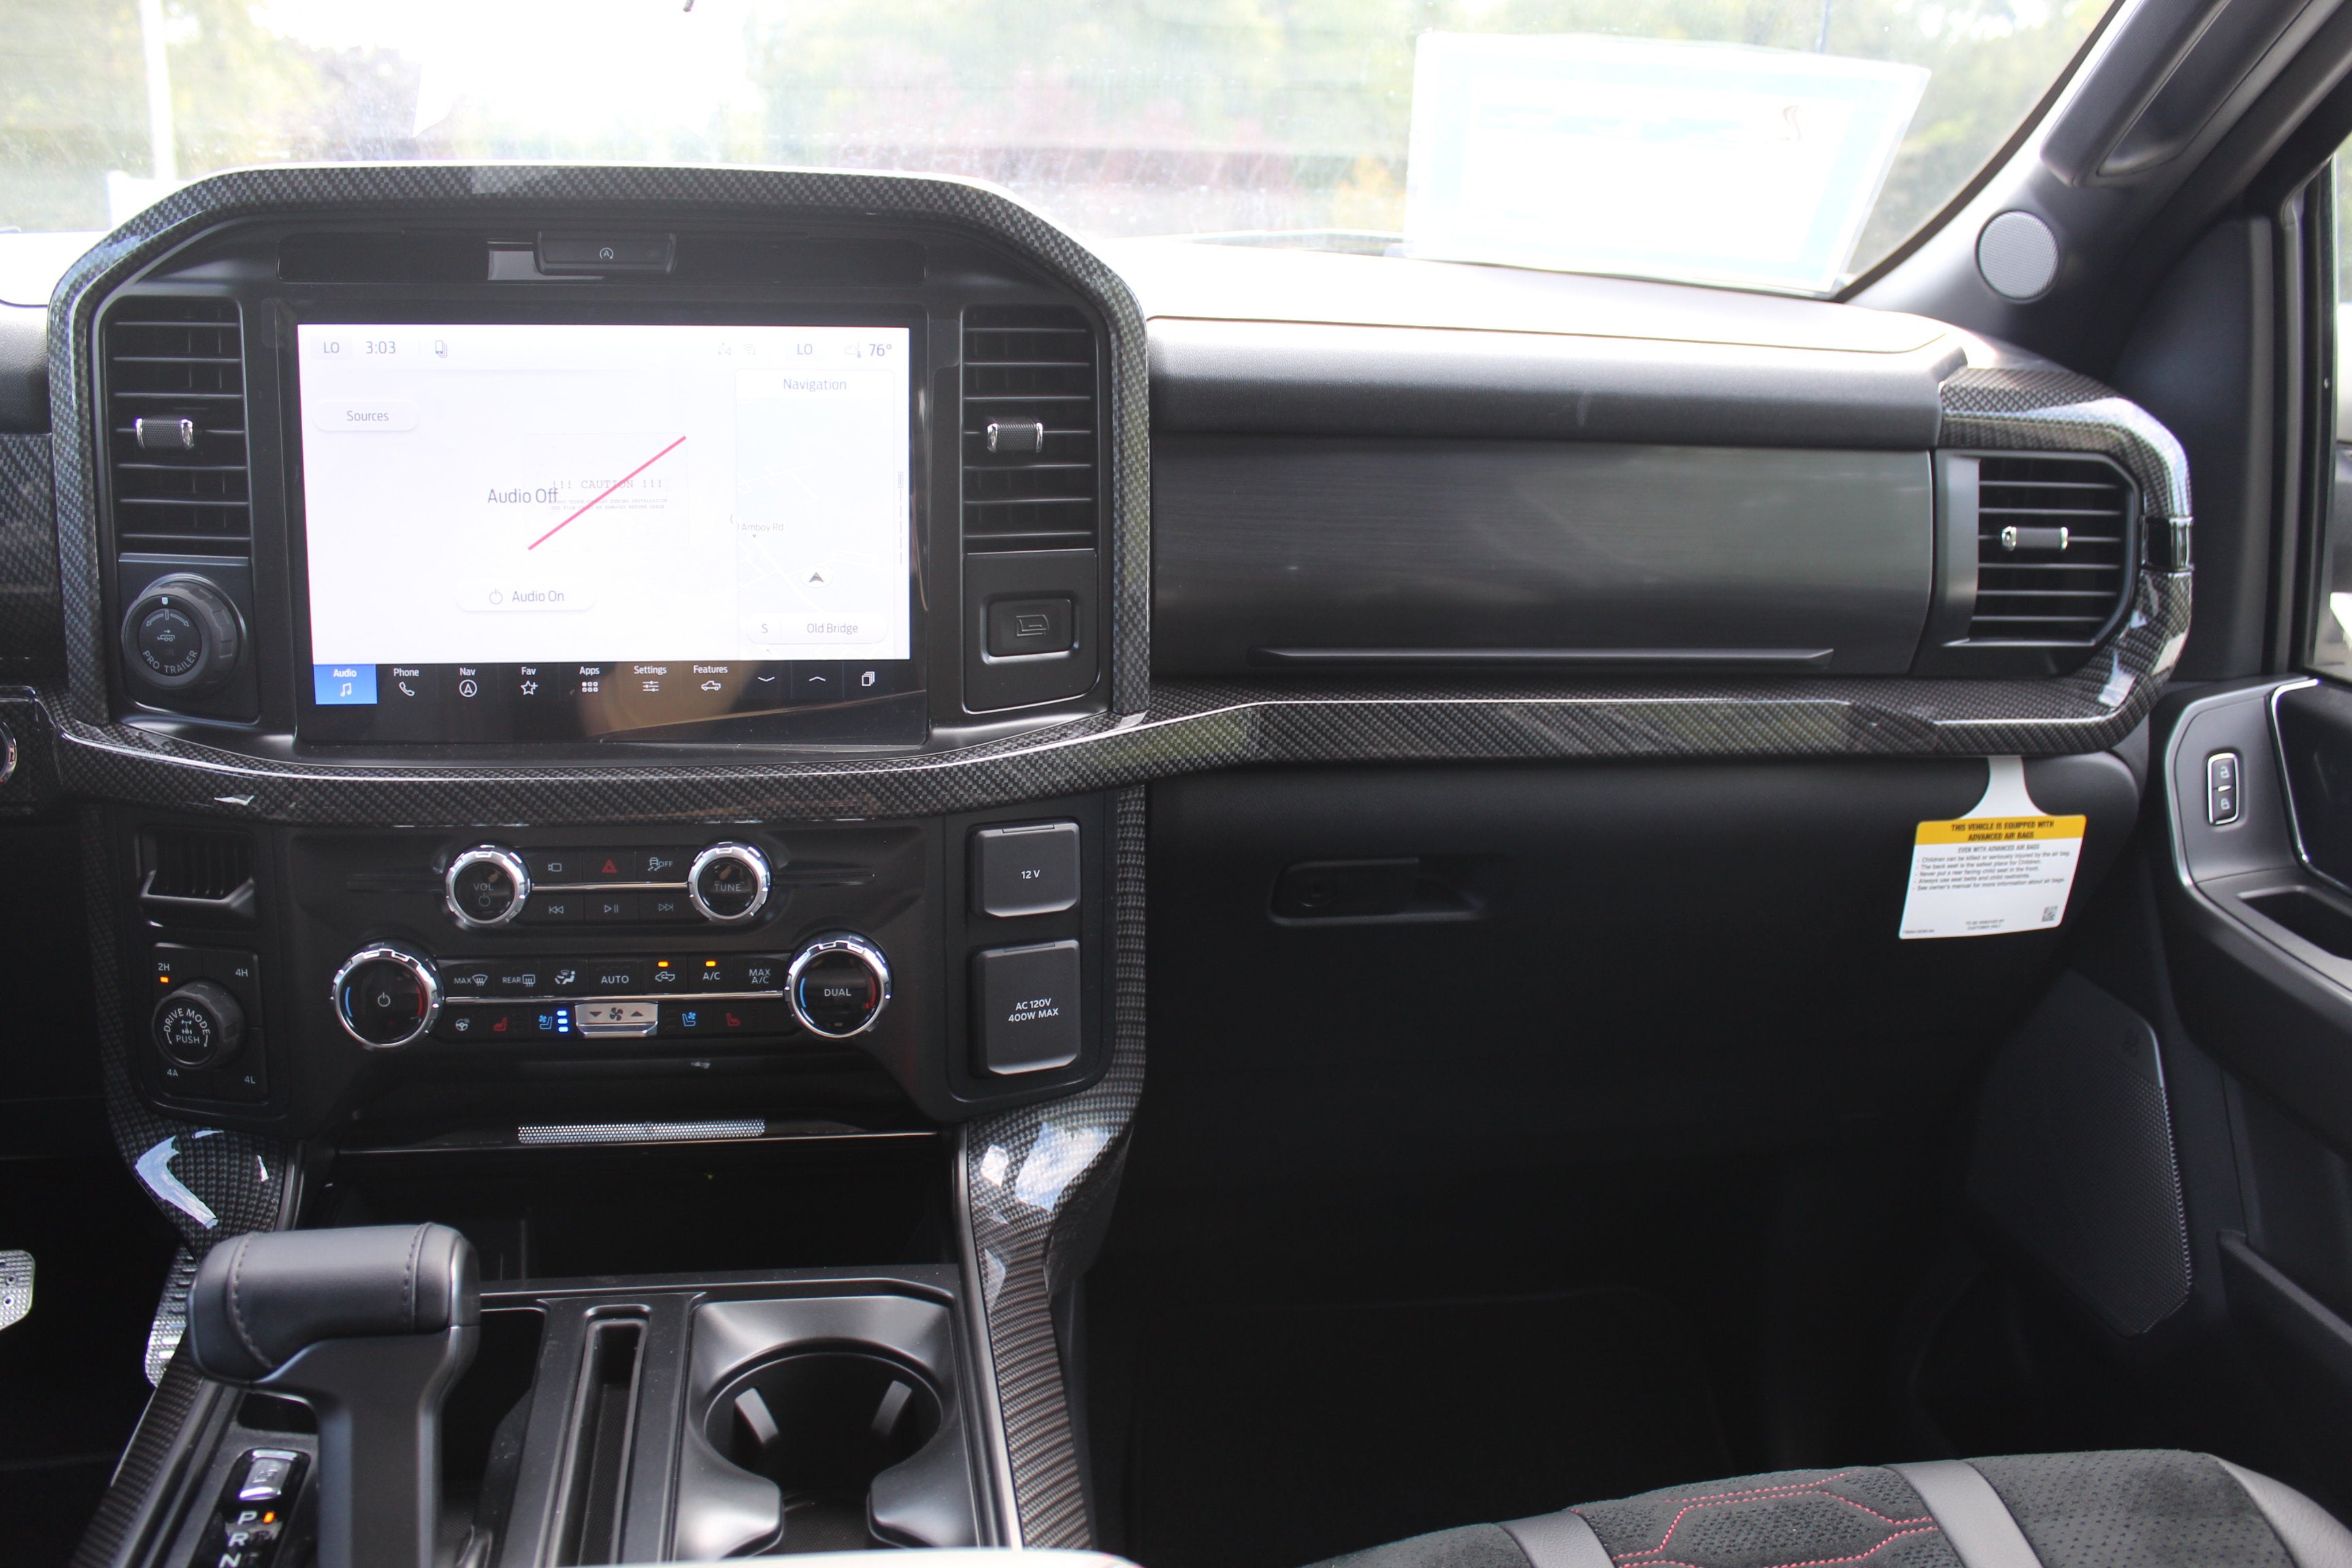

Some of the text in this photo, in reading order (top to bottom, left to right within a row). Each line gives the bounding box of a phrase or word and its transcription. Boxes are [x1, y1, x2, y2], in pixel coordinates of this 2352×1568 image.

[323, 341, 340, 354] LO
[365, 341, 396, 354] 3:03
[796, 343, 813, 355] LO
[868, 343, 892, 357] 76°
[783, 378, 847, 392] Navigation
[346, 410, 389, 422] Sources
[487, 487, 559, 504] Audio Off
[741, 523, 770, 532] Amboy
[772, 523, 784, 532] Rd
[512, 590, 565, 602] Audio On
[761, 623, 768, 634] S
[806, 623, 858, 635] Old Bridge
[142, 649, 198, 674] PRO TRAILER
[333, 668, 357, 677] Audio
[393, 667, 419, 676] Phone
[459, 667, 476, 676] Nav
[521, 666, 536, 676] Fav
[578, 666, 600, 677] Apps
[634, 665, 667, 676] Settings
[693, 665, 728, 674] Features
[1951, 823, 1966, 832] THIS
[1967, 822, 1994, 831] VEHICLE
[1967, 832, 2003, 841] ADVANCED
[658, 860, 673, 868] OFF
[1021, 869, 1041, 879] 12 V
[472, 883, 493, 892] VOL
[714, 883, 741, 892] TUNE
[158, 962, 170, 972] 2H
[235, 968, 248, 977] 4H
[702, 971, 721, 981] A/C
[749, 968, 771, 977] MAX
[454, 977, 472, 985] MAX
[600, 975, 630, 984] AUTO
[751, 975, 769, 985] A/C
[823, 987, 851, 997] DUAL
[1015, 998, 1051, 1011] AC 120V
[1008, 1007, 1059, 1023] 400W MAX
[163, 1008, 210, 1035] DRIVE MODE
[176, 1035, 200, 1044] PUSH
[167, 1068, 179, 1077] 4A
[244, 1075, 256, 1084] 4L
[237, 1510, 257, 1526] P
[227, 1531, 249, 1547] R
[218, 1552, 242, 1568] N
